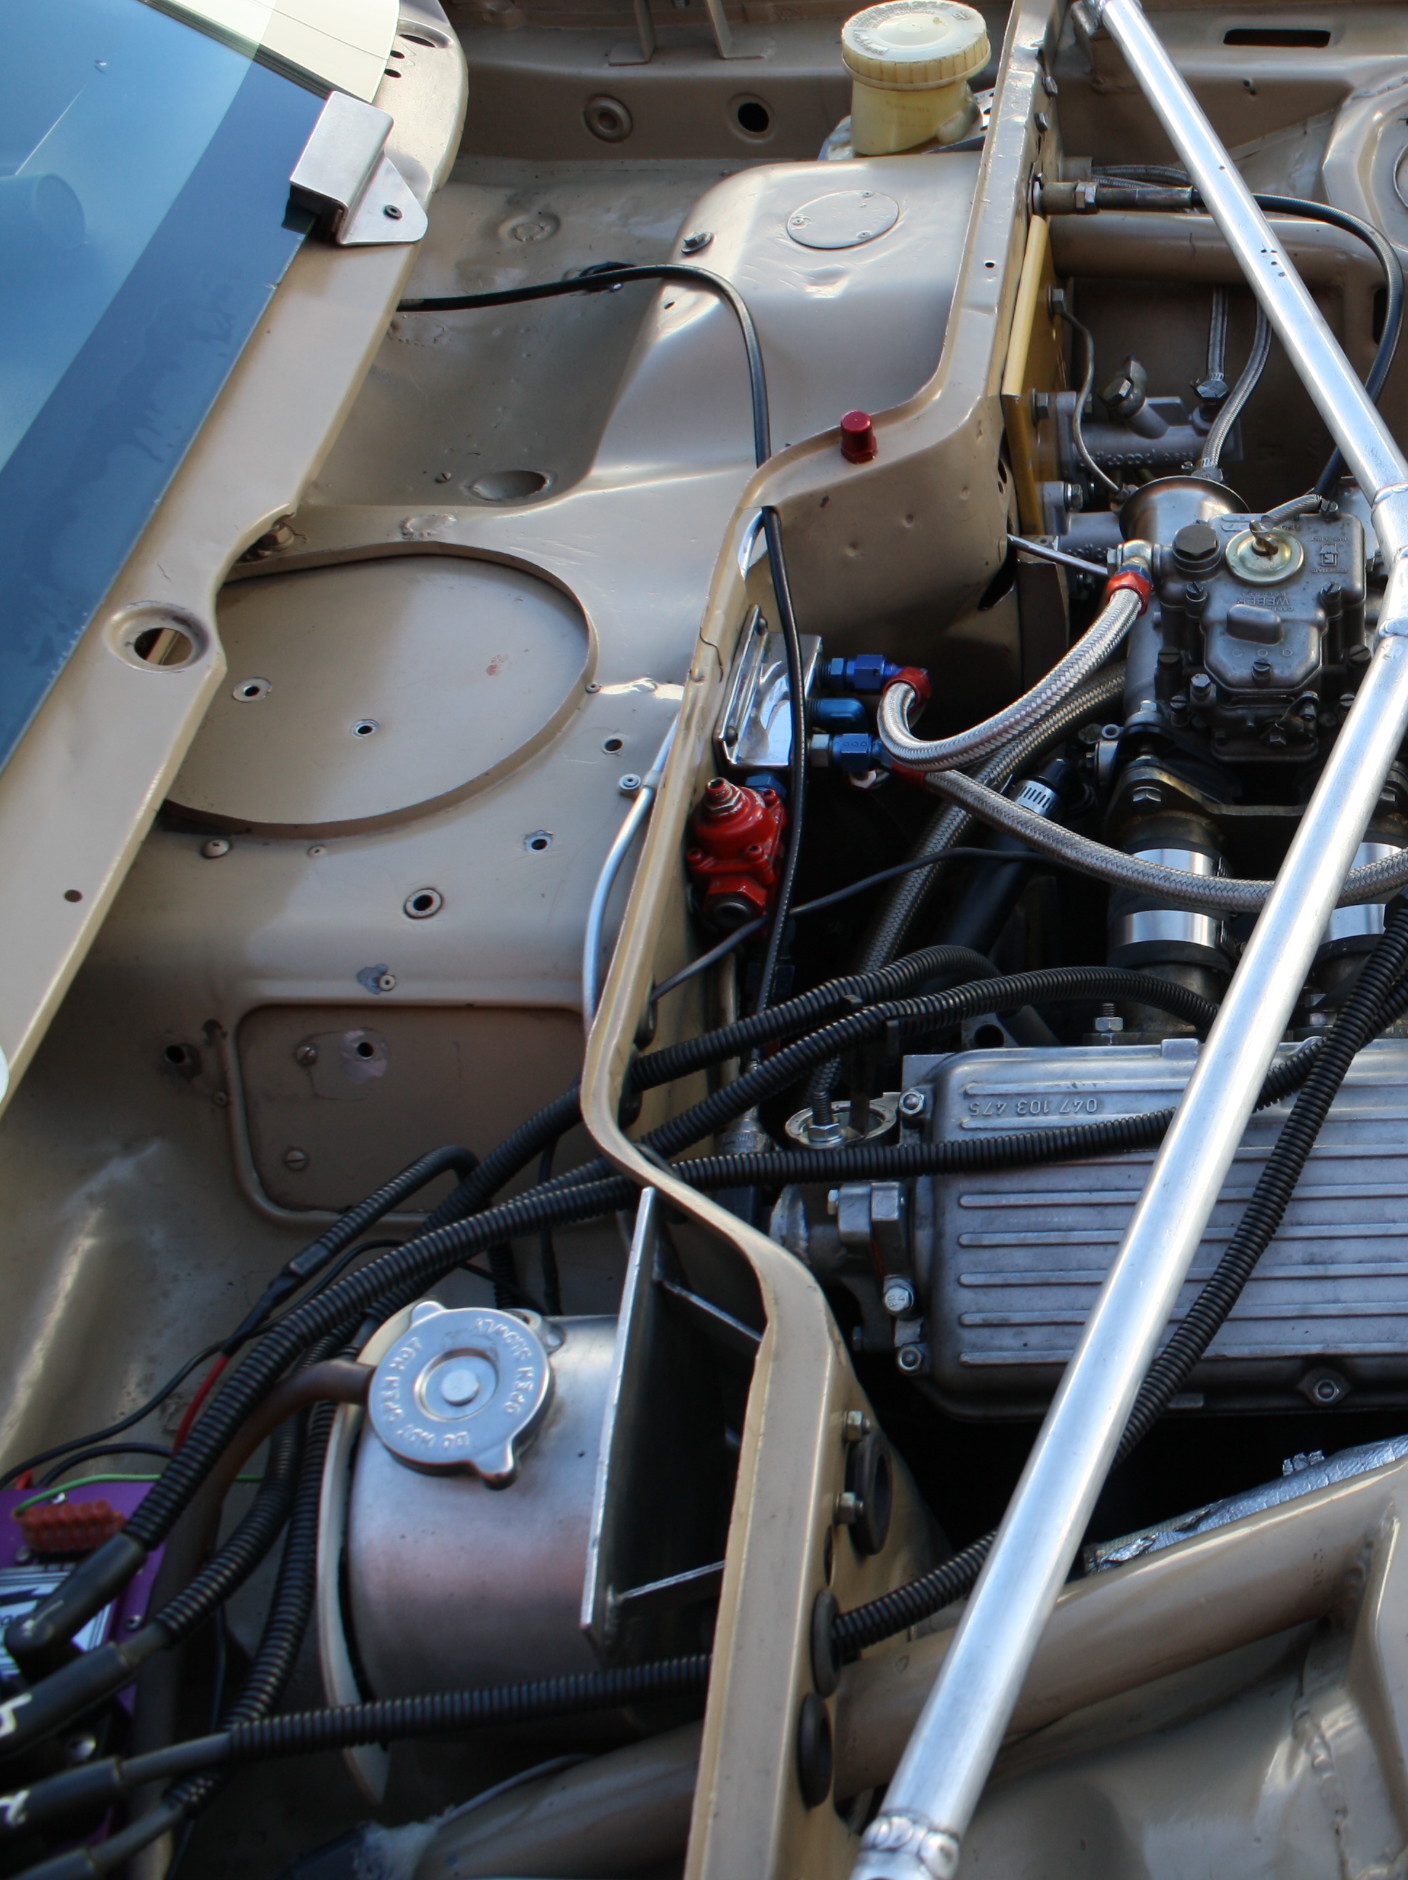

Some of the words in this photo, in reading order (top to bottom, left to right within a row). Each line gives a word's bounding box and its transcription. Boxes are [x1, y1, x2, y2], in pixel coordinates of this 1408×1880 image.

[968, 1100, 1007, 1117] 475
[1016, 1099, 1050, 1115] 103
[1059, 1097, 1098, 1114] 047
